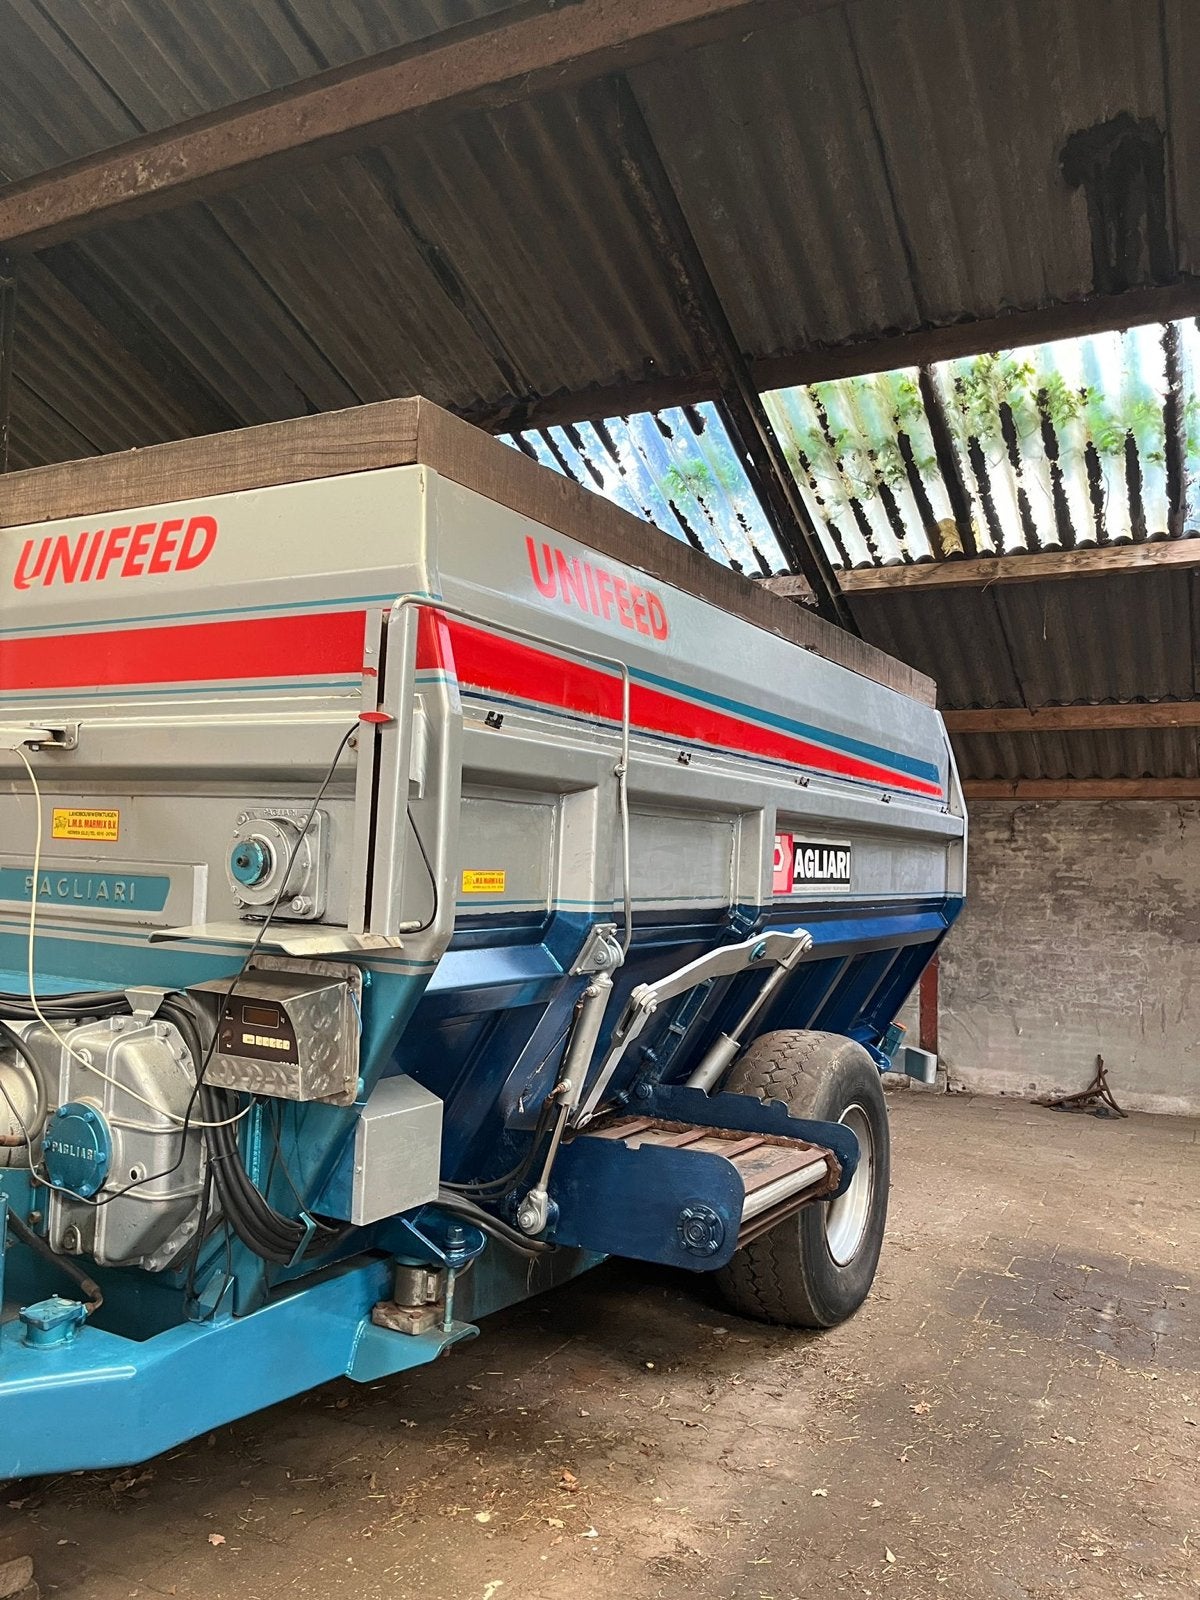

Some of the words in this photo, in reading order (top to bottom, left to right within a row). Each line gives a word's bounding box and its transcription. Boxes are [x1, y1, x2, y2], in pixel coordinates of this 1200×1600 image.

[14, 515, 218, 591] UNIFEED
[525, 535, 670, 642] UNIFEED
[24, 875, 136, 904] PAGLIARI
